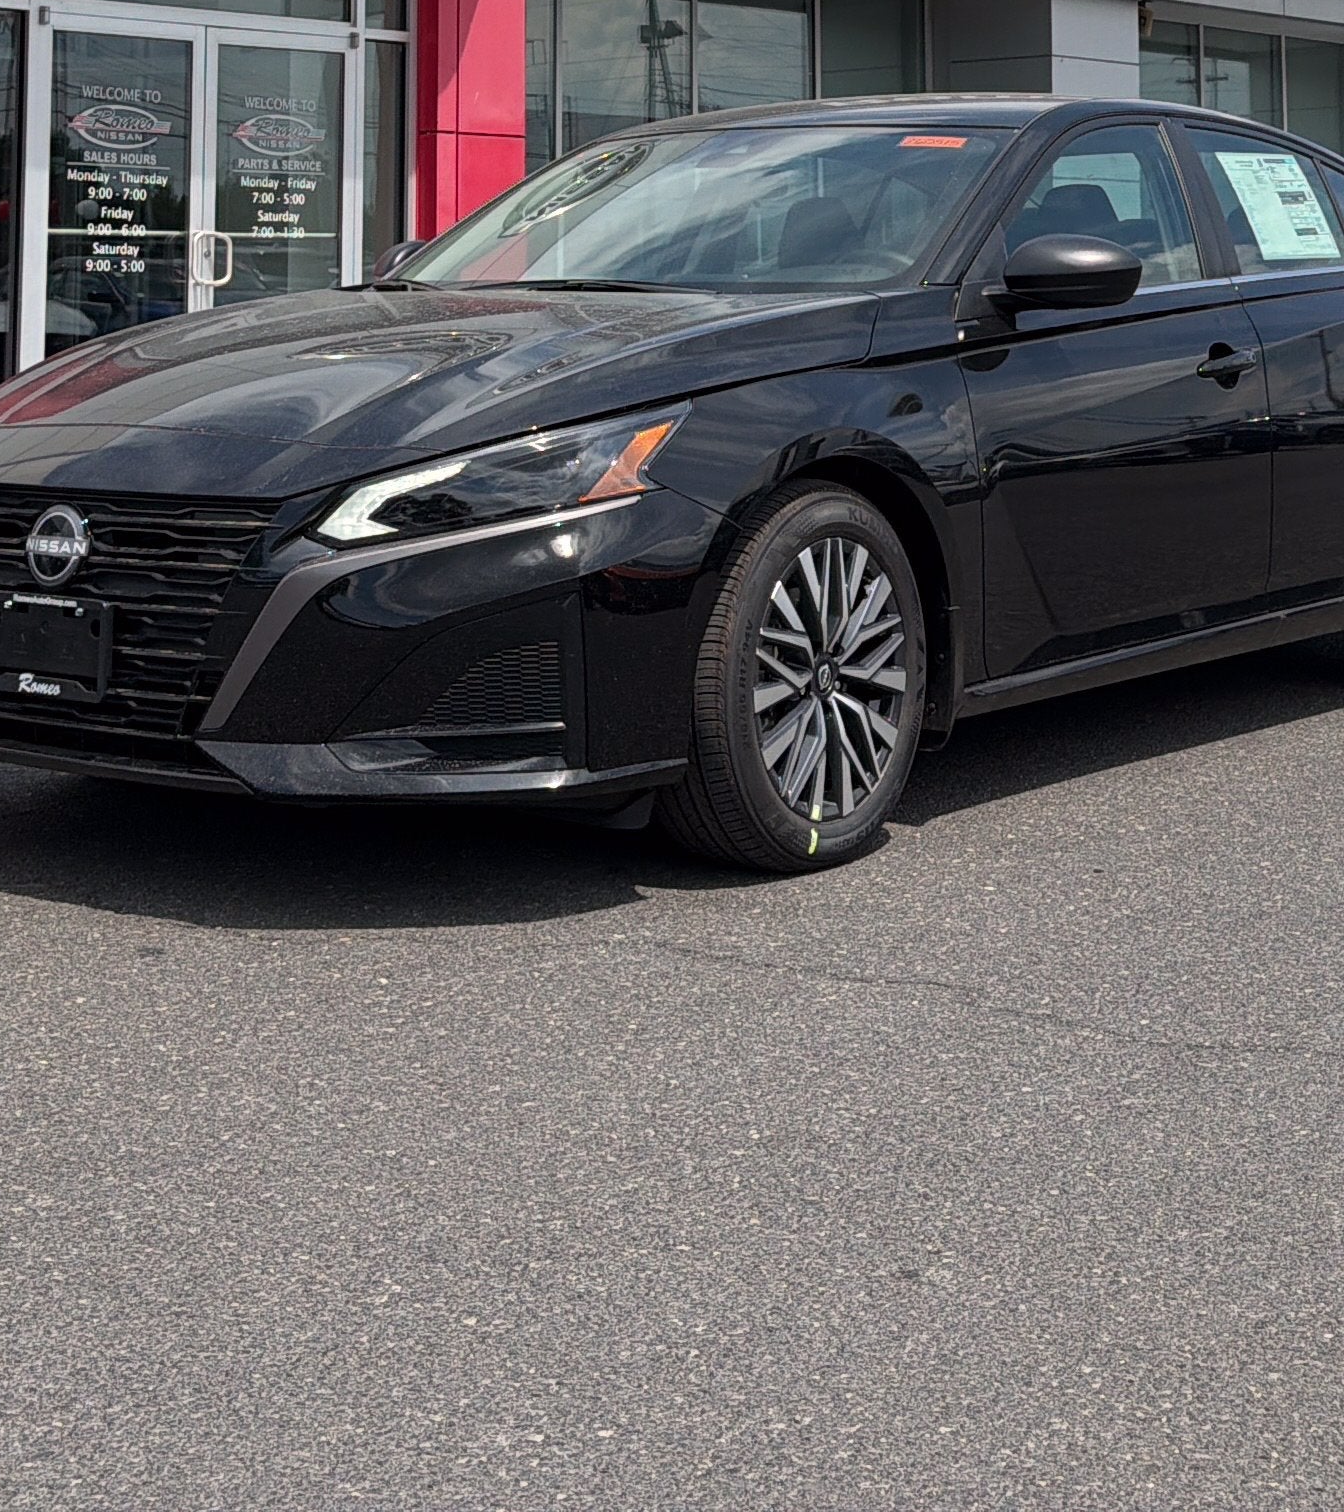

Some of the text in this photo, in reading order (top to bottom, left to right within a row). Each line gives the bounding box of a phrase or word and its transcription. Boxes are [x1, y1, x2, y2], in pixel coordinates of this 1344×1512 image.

[82, 85, 161, 103] WELCOME TO
[244, 96, 316, 112] WELCOME TO
[91, 108, 156, 131] Romeo
[255, 119, 312, 137] Romeo
[97, 131, 142, 141] NISSAN
[258, 140, 300, 149] NISSAN
[83, 150, 157, 165] SALES HOURS
[238, 158, 322, 172] PARTS & SERVICE
[67, 169, 110, 184] Monday
[120, 171, 168, 187] Thursday
[240, 176, 279, 190] Monday
[287, 177, 317, 191] Friday
[88, 187, 113, 200] 9:00
[123, 188, 147, 201] 7:00
[252, 192, 274, 204] 7:00
[283, 193, 305, 205] 5:00
[101, 207, 134, 221] Friday
[257, 210, 300, 224] Saturday
[87, 223, 112, 236] 9:00
[121, 224, 146, 237] 6:00
[251, 226, 274, 238] 7:00
[92, 242, 140, 258] Saturday
[85, 259, 111, 272] 9:00
[120, 260, 145, 273] 5:00
[26, 539, 86, 554] NISSAN
[18, 672, 61, 695] Romeo
